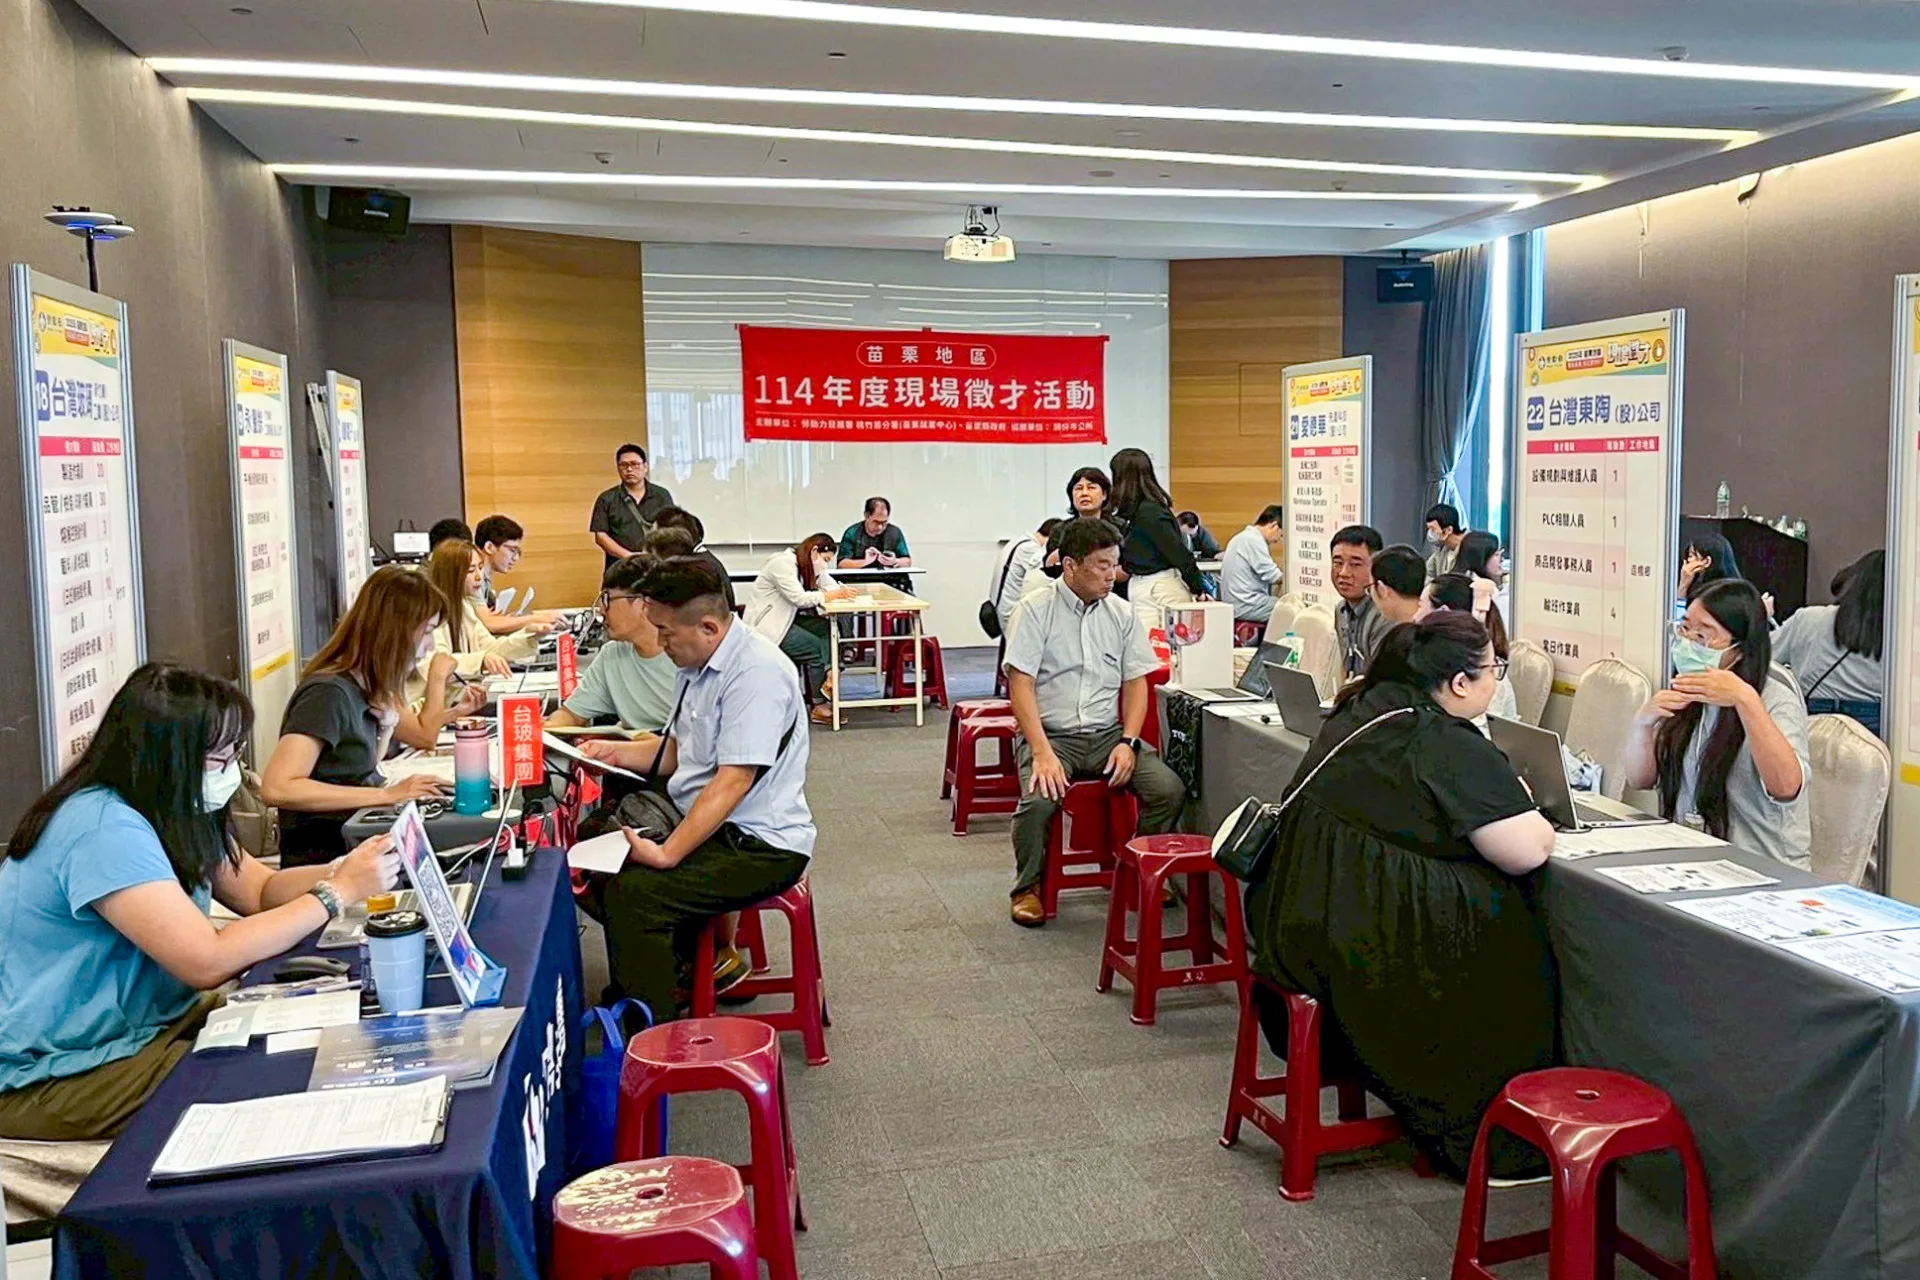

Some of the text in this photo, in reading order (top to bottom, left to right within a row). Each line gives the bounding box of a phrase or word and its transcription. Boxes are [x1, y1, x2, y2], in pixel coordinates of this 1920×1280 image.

[866, 345, 987, 366] 苗栗地區
[755, 375, 1095, 411] 114年度現場徵才活動
[1527, 404, 1544, 425] 22
[1549, 394, 1611, 426] 台灣東陶
[1542, 512, 1585, 528] PLC相關人員
[1534, 554, 1593, 573] 商品開發事務人員
[1543, 598, 1581, 617] 輪班作業員
[513, 704, 533, 780] 台玻集團
